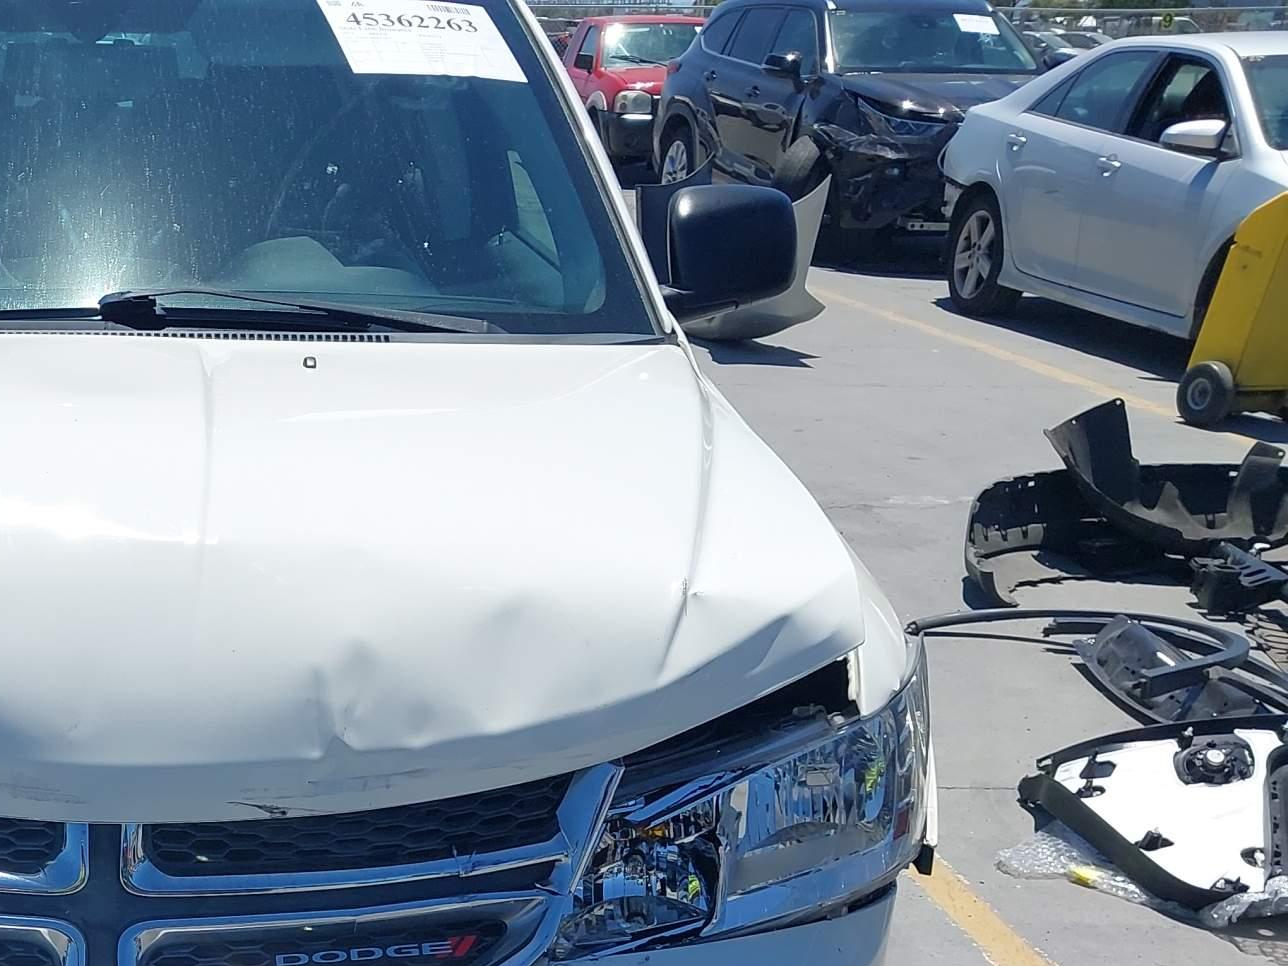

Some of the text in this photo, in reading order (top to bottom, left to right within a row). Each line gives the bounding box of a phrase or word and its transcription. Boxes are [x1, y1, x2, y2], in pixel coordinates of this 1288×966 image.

[346, 12, 479, 33] 45362263
[1163, 13, 1173, 28] 9
[275, 941, 453, 966] DODGE
